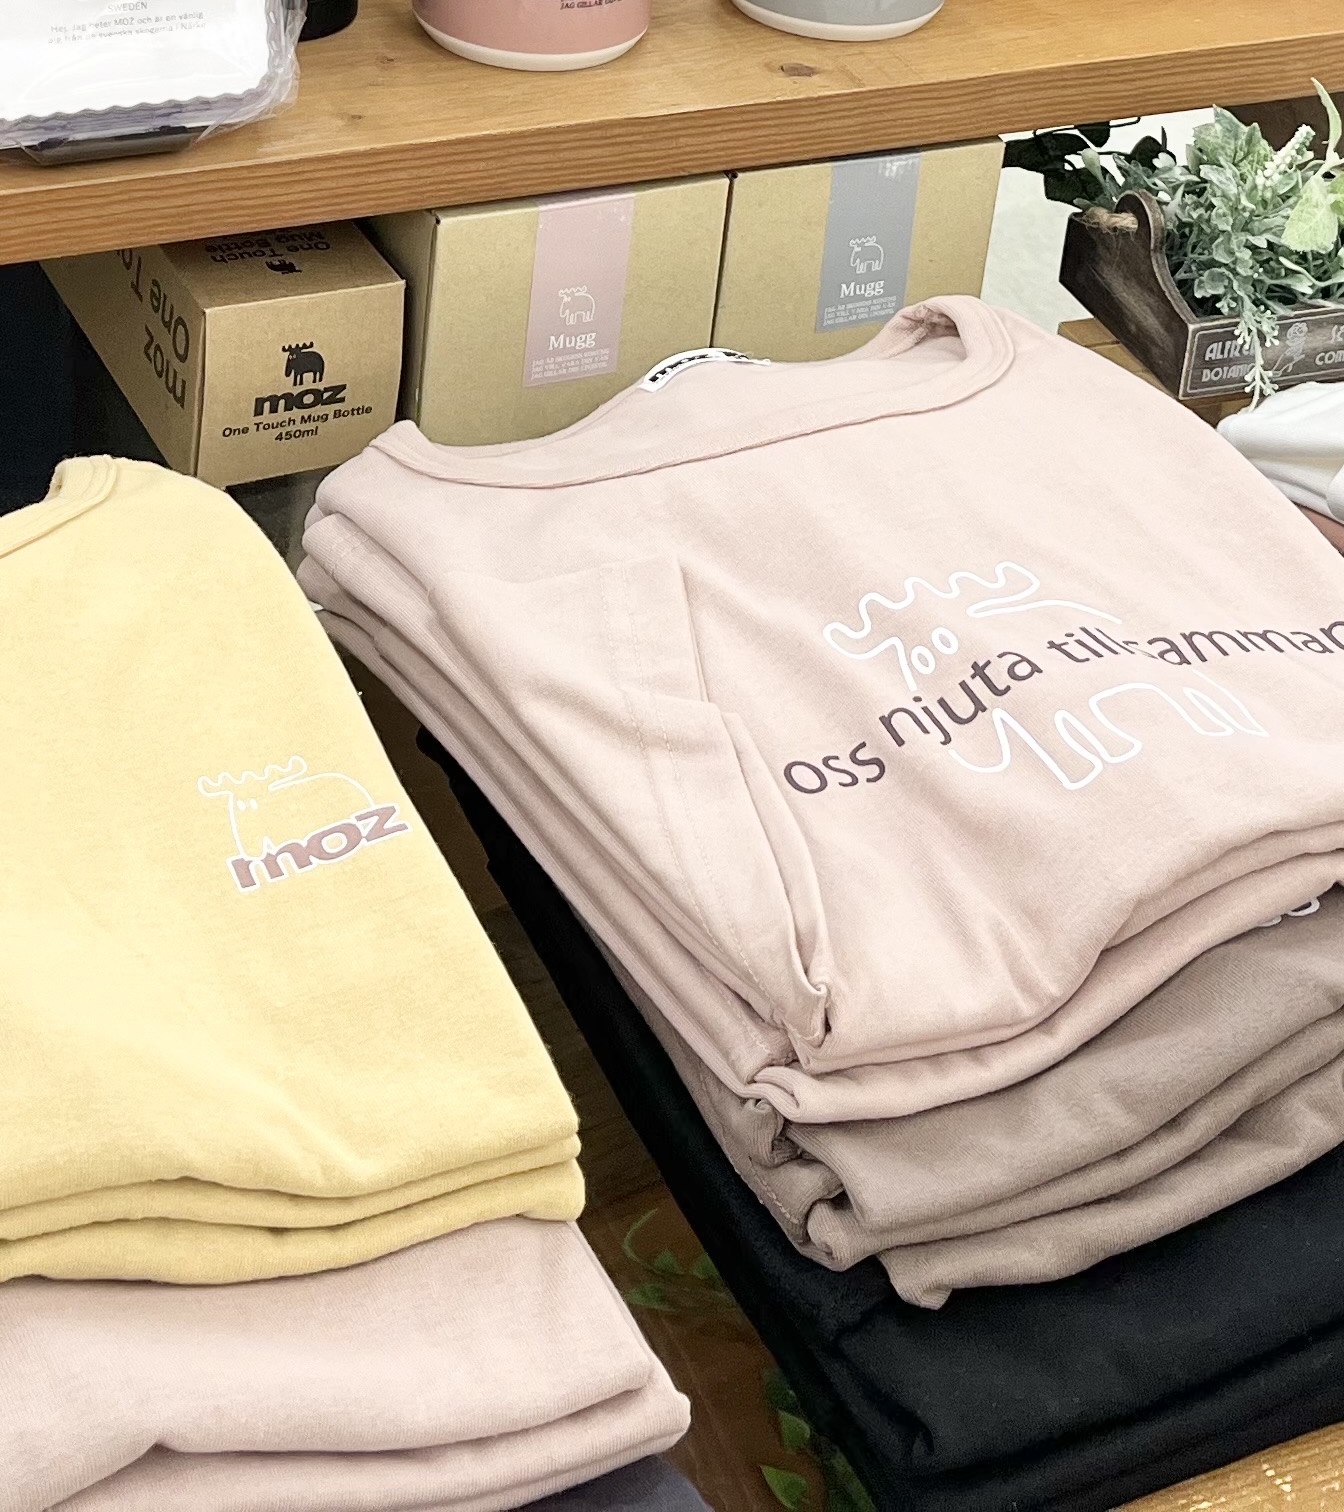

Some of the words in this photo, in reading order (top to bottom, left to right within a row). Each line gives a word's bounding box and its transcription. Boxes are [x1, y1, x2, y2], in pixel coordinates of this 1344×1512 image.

[107, 1, 148, 13] SWEDEN
[840, 280, 885, 298] Mugg
[548, 332, 597, 351] Mugg
[143, 324, 187, 409] moz
[253, 384, 348, 418] moz
[222, 426, 250, 438] One
[253, 416, 297, 433] Touch
[299, 411, 329, 425] Mug
[333, 404, 373, 420] Bottle
[274, 426, 320, 442] 450ml
[782, 739, 886, 795] oss
[878, 645, 1044, 747] njuta
[228, 803, 411, 891] moz
